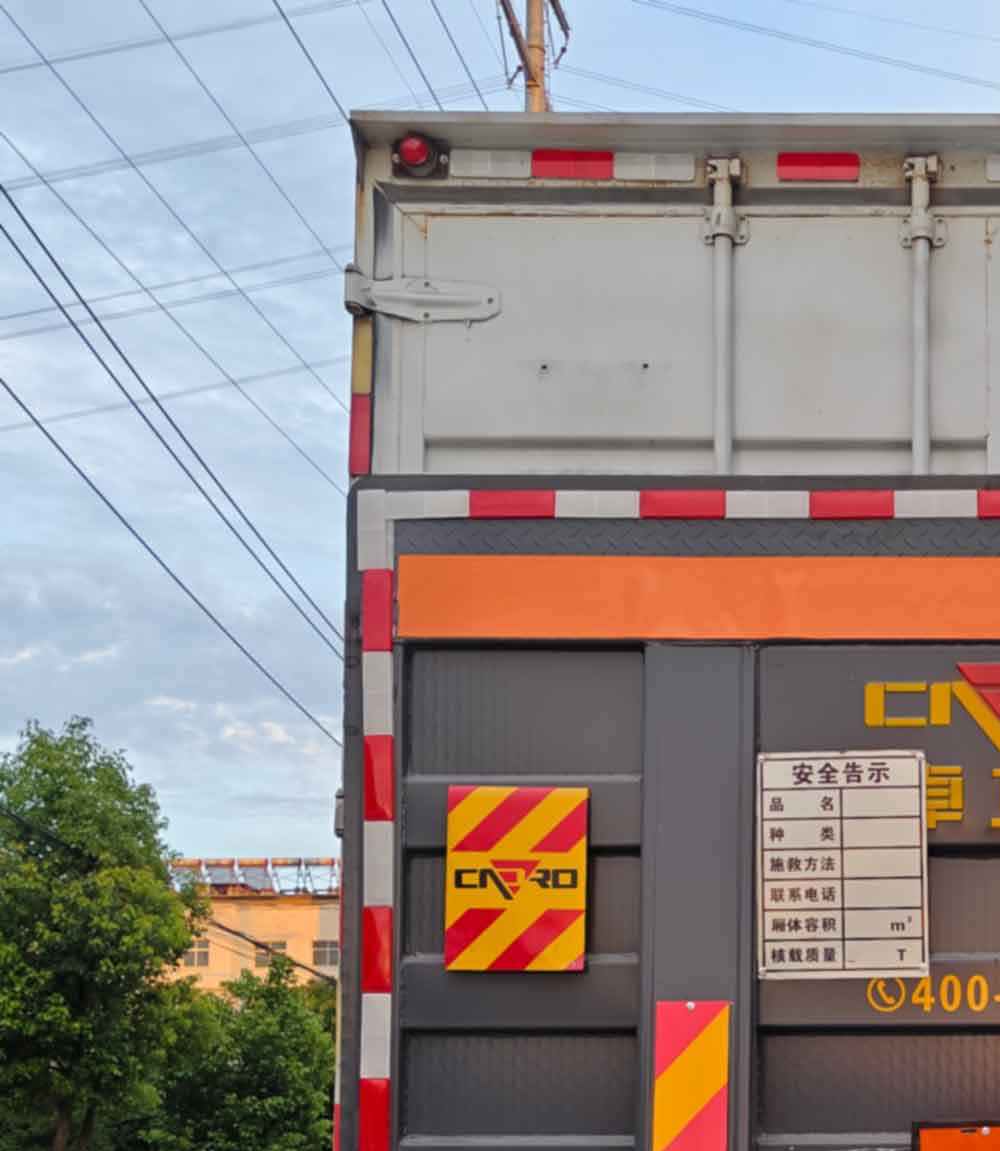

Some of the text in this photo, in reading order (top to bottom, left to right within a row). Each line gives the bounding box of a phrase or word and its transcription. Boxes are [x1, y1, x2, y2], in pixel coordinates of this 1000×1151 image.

[792, 762, 890, 785] 安全告示
[770, 887, 836, 902] 联系电话
[771, 948, 836, 963] 核载质量
[897, 948, 907, 961] T
